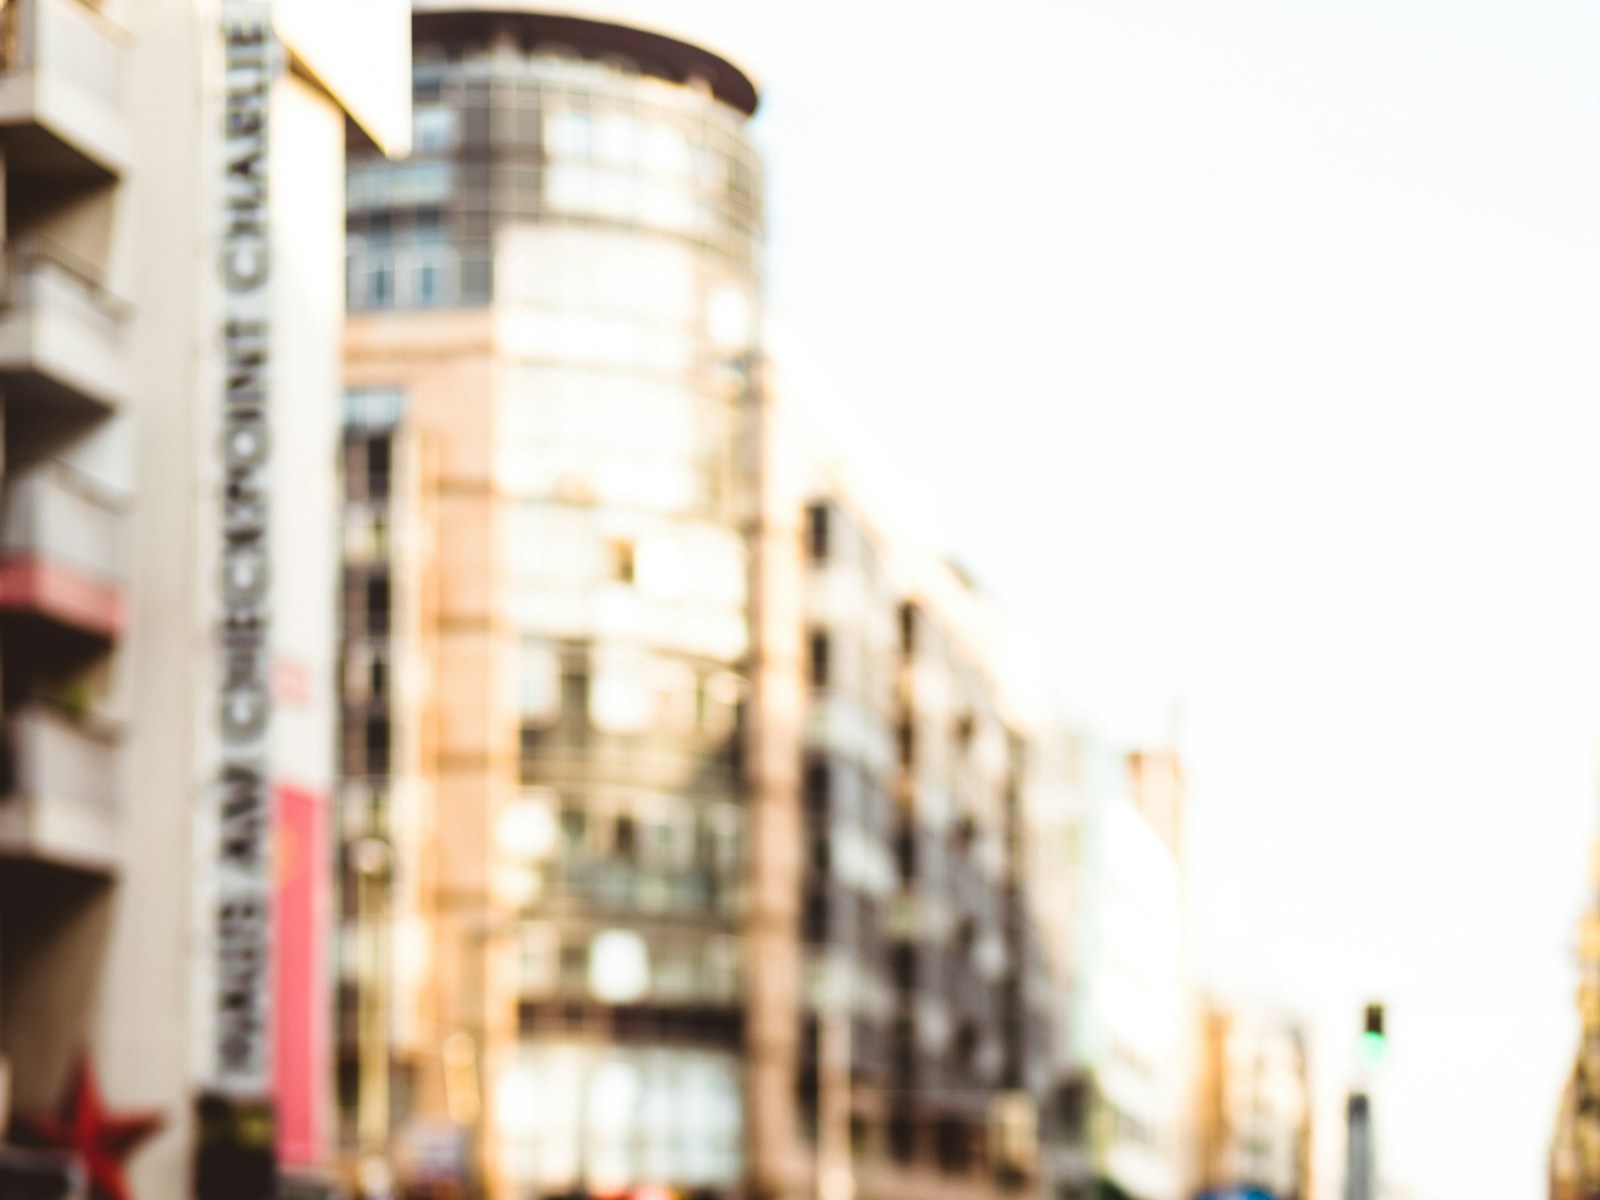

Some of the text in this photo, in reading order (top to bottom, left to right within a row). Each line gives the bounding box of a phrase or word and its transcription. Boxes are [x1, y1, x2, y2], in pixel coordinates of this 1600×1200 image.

[219, 22, 269, 294] CHARLIE
[218, 317, 268, 745] CHECKPOINT
[218, 764, 267, 872] AM
